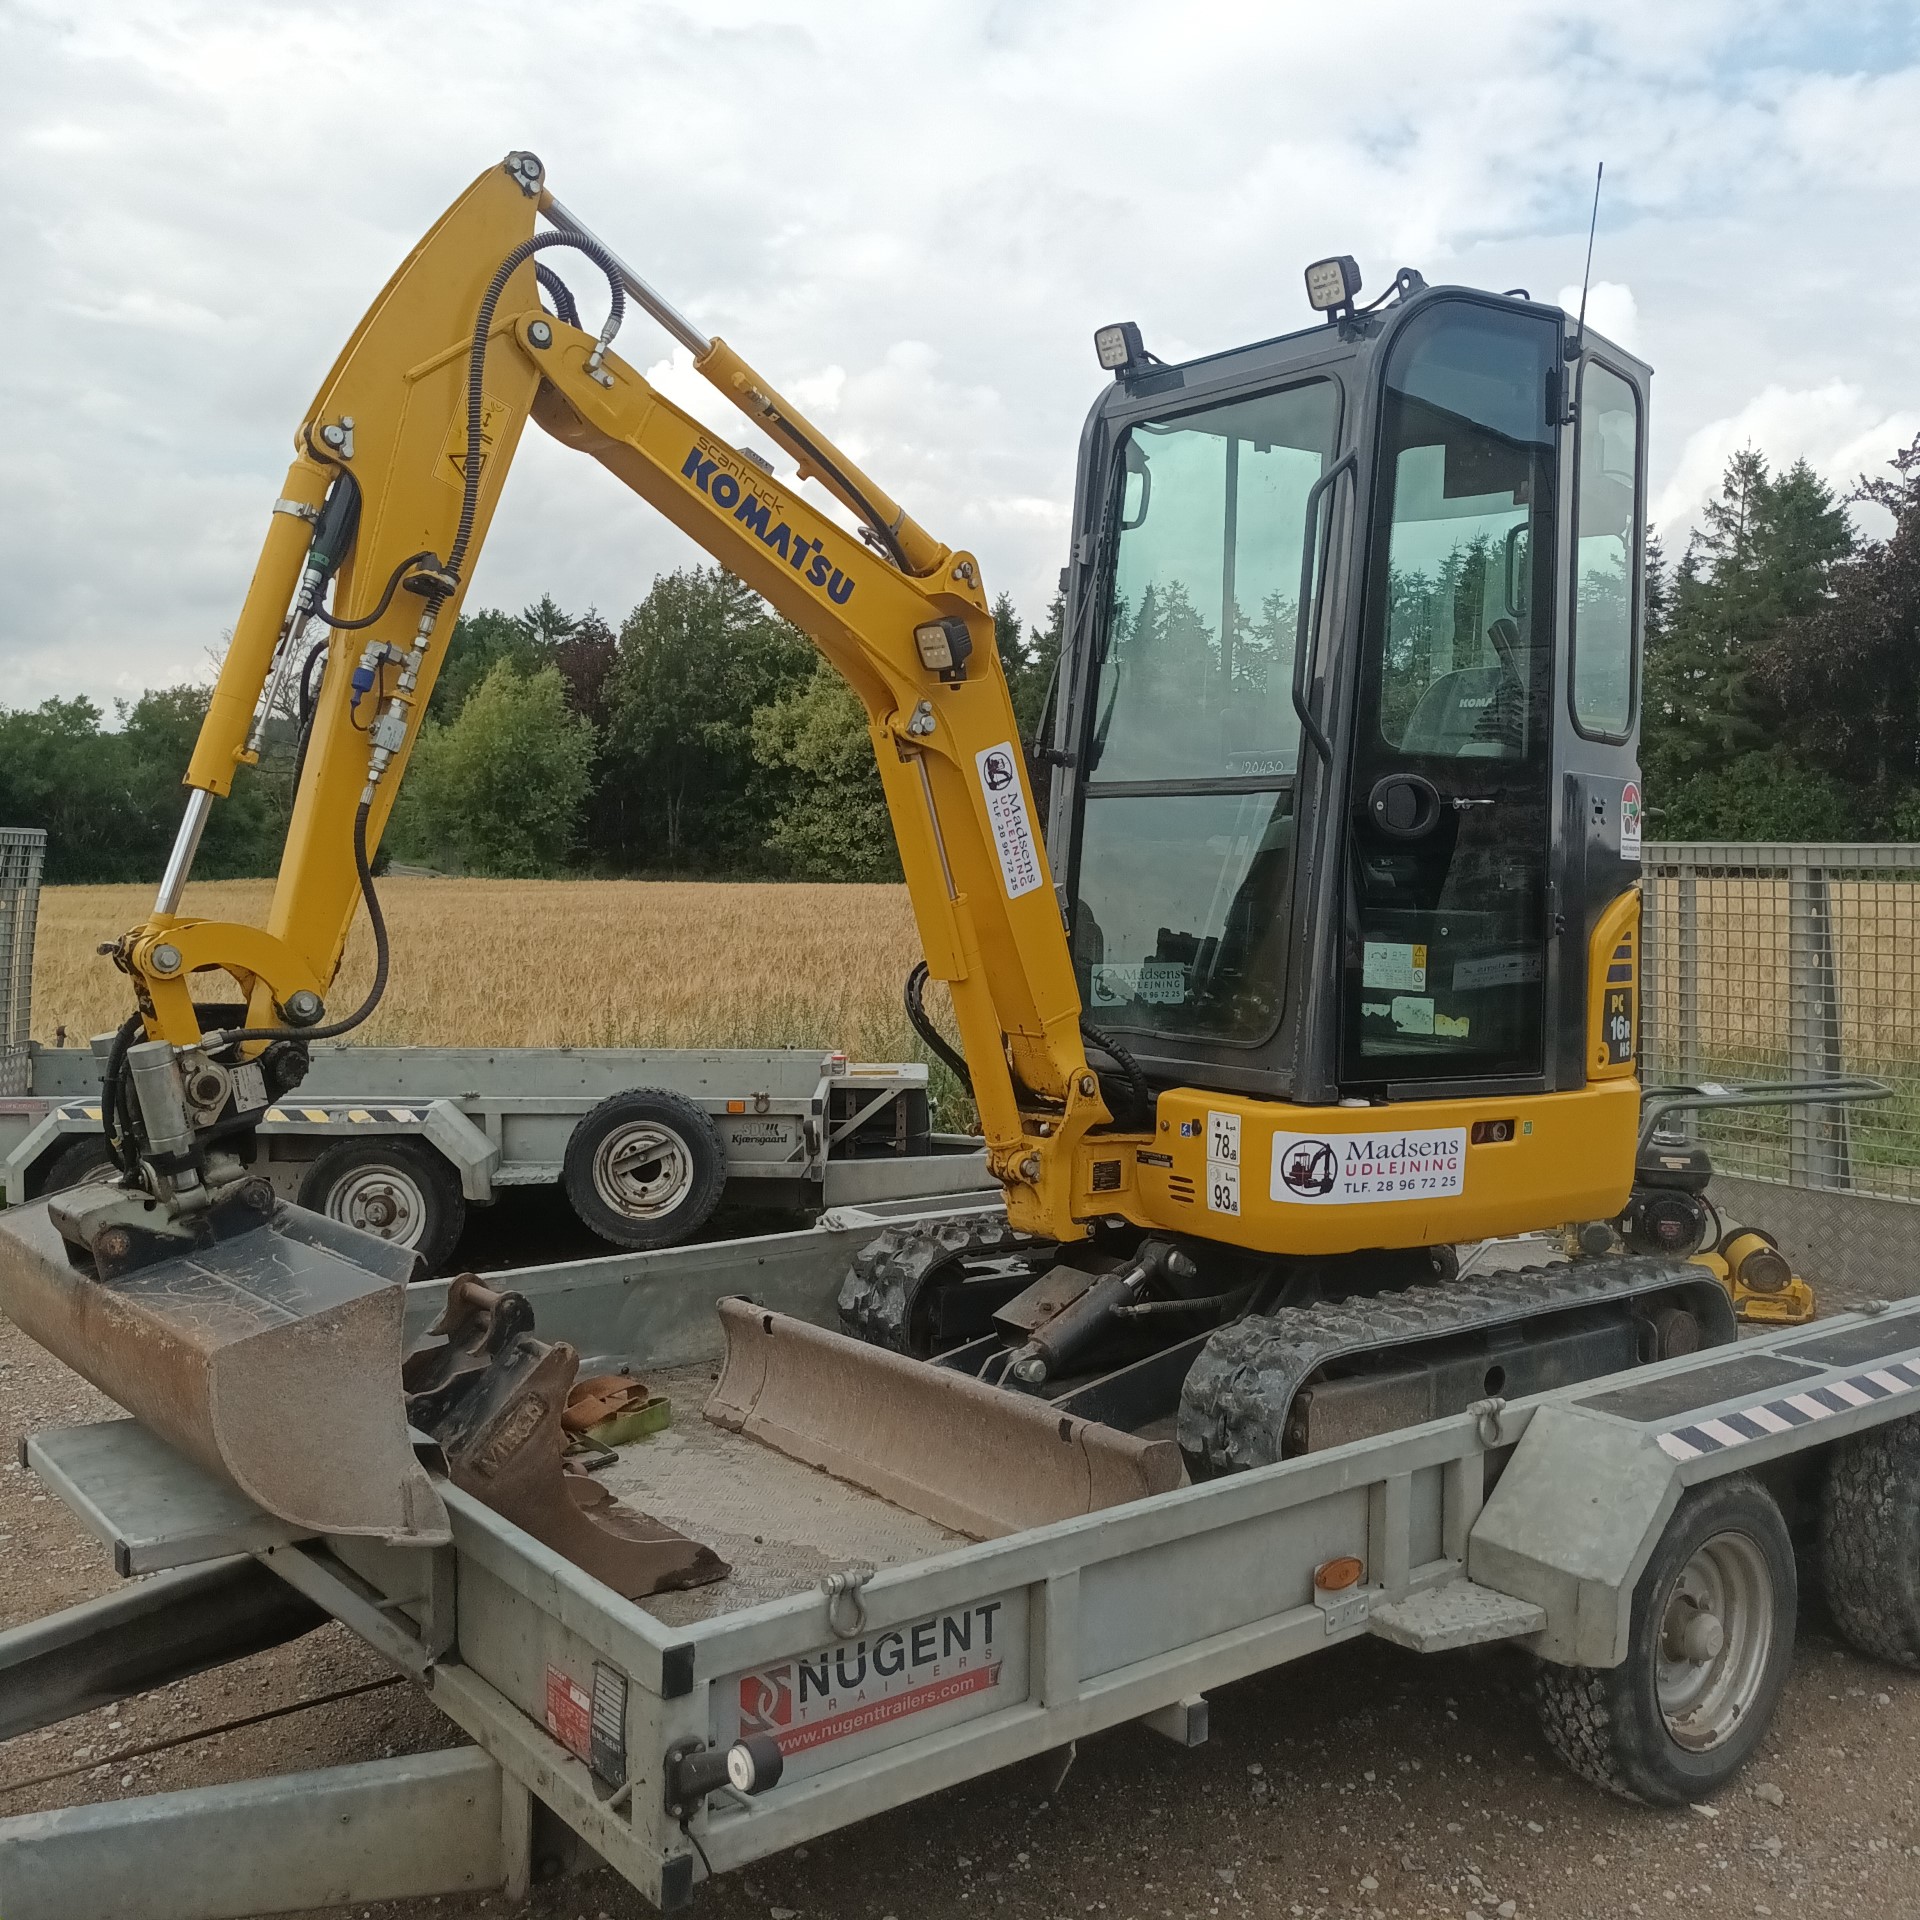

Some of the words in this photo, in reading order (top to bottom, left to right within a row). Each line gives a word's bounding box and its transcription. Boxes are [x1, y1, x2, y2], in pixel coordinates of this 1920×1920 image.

[697, 436, 786, 516] scantruck
[681, 446, 856, 605] KOMATSU
[997, 825, 1006, 839] 28
[1000, 795, 1026, 887] UDLEJNING
[1007, 791, 1036, 884] Madsens
[1002, 842, 1010, 856] 96
[1006, 860, 1015, 873] 72
[1010, 877, 1019, 891] 25
[1127, 980, 1181, 990] DLEJNING
[1611, 994, 1624, 1014] PC
[1619, 1042, 1630, 1058] HS
[731, 1134, 788, 1146] Kjærsgaard
[1214, 1133, 1230, 1159] 78
[1229, 1149, 1237, 1161] dB
[1345, 1137, 1459, 1161] Madsens
[1345, 1157, 1458, 1177] UDLEJNING
[1343, 1182, 1371, 1194] TLF.
[1376, 1180, 1394, 1192] 28
[1398, 1178, 1416, 1191] 96
[1420, 1177, 1437, 1189] 72
[1440, 1176, 1457, 1188] 25
[1214, 1184, 1231, 1210] 93
[1230, 1201, 1238, 1212] dB
[799, 1601, 1001, 1704] NUGENT
[800, 1648, 993, 1719] TRAILERS
[777, 1676, 975, 1752] www.nugenttrailers.com
